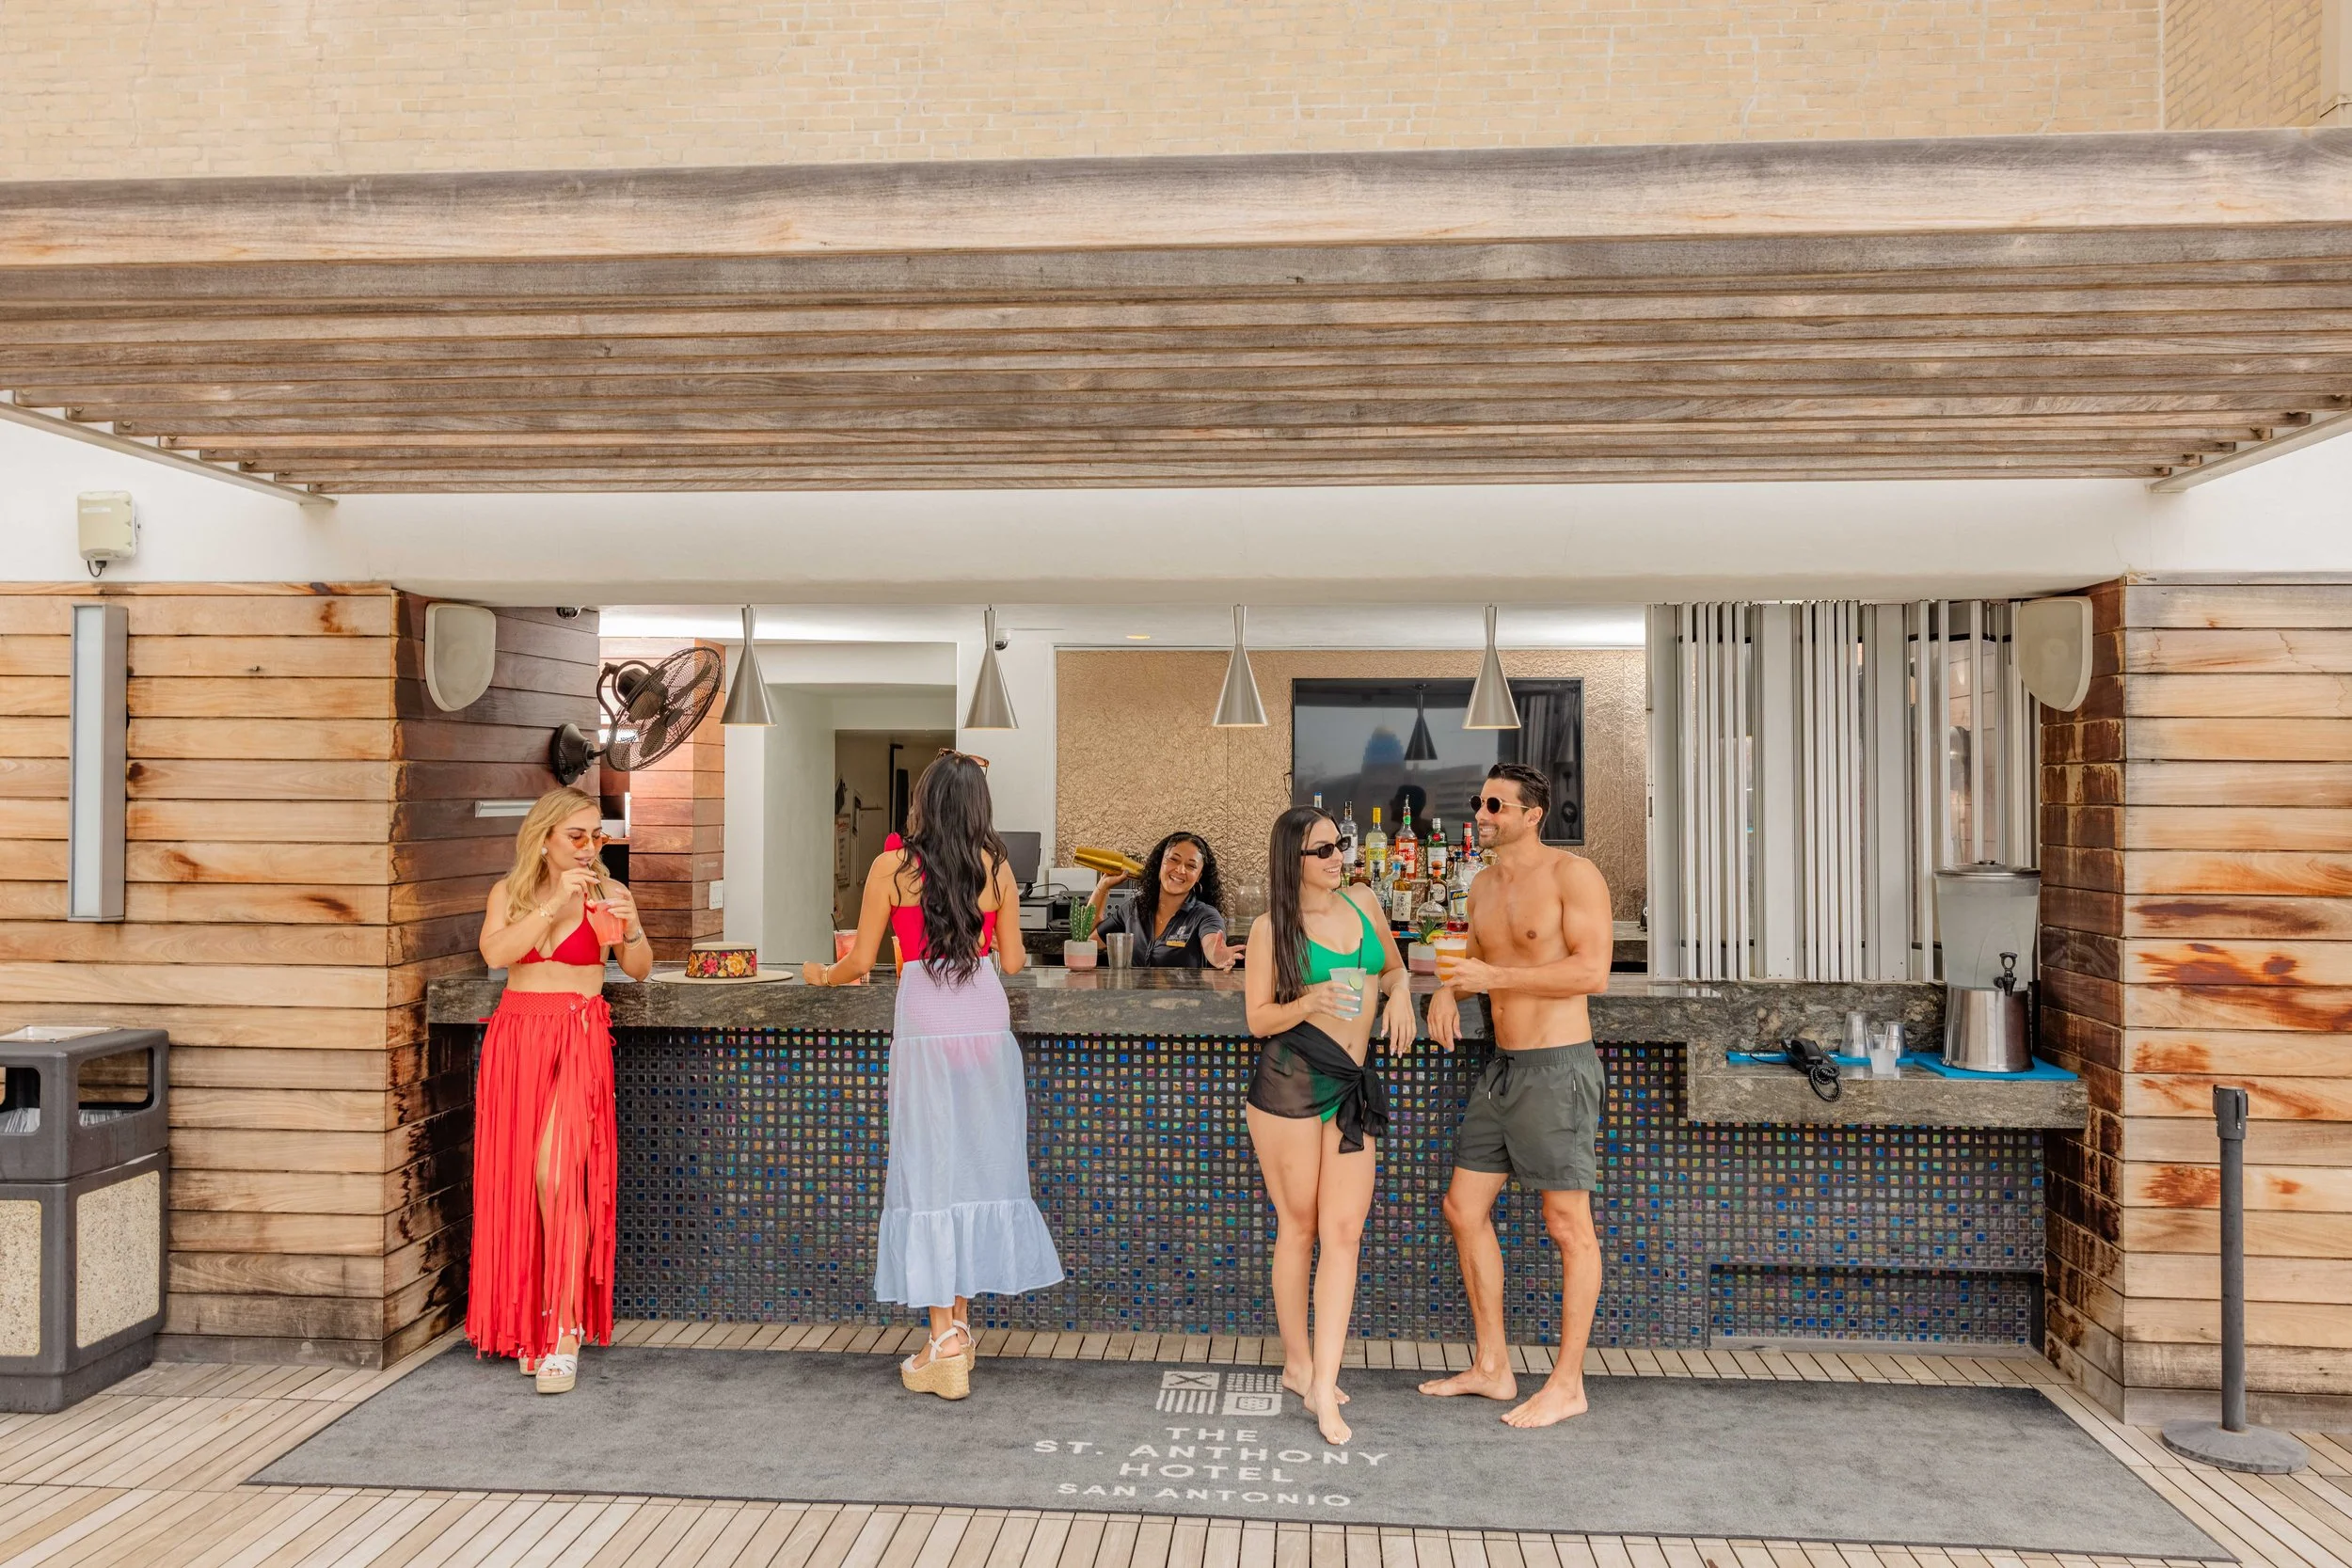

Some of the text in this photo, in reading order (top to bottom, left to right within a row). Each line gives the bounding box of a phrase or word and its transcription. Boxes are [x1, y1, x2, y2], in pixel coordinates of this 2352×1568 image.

[1166, 1427, 1258, 1442] THE
[1033, 1439, 1389, 1466] ST. ANTHONY
[1119, 1462, 1294, 1482] HOTEL
[1057, 1482, 1351, 1507] SAN ANTONIO
